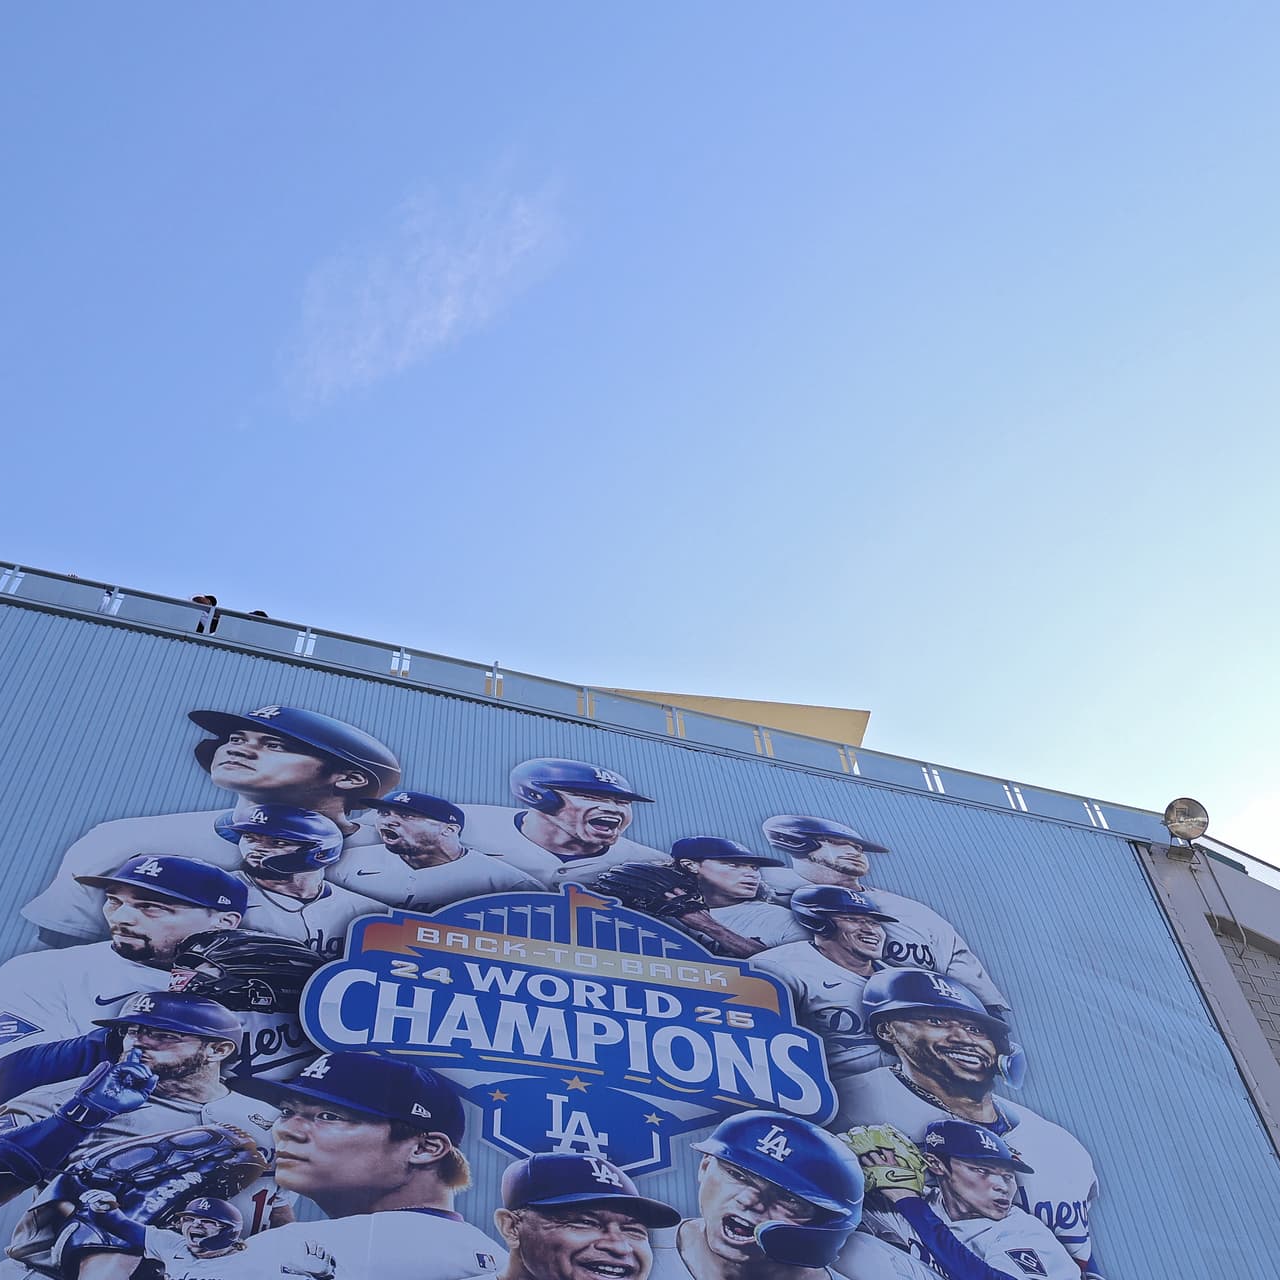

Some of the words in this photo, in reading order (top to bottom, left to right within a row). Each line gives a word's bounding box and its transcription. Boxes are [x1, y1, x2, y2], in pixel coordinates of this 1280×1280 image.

[249, 705, 280, 718] LA
[590, 767, 618, 784] LA
[393, 792, 411, 803] LA
[249, 809, 268, 823] LA
[134, 858, 163, 877] LA
[417, 926, 728, 987] BACK-TO-BACK
[390, 959, 454, 984] 24
[464, 962, 682, 1019] WORLD
[694, 1006, 756, 1029] 25
[924, 973, 961, 1000] LA
[319, 969, 821, 1115] CHAMPIONS
[546, 1093, 608, 1160] LA
[755, 1124, 792, 1162] LA
[976, 1130, 1000, 1152] LA
[583, 1157, 623, 1188] LA
